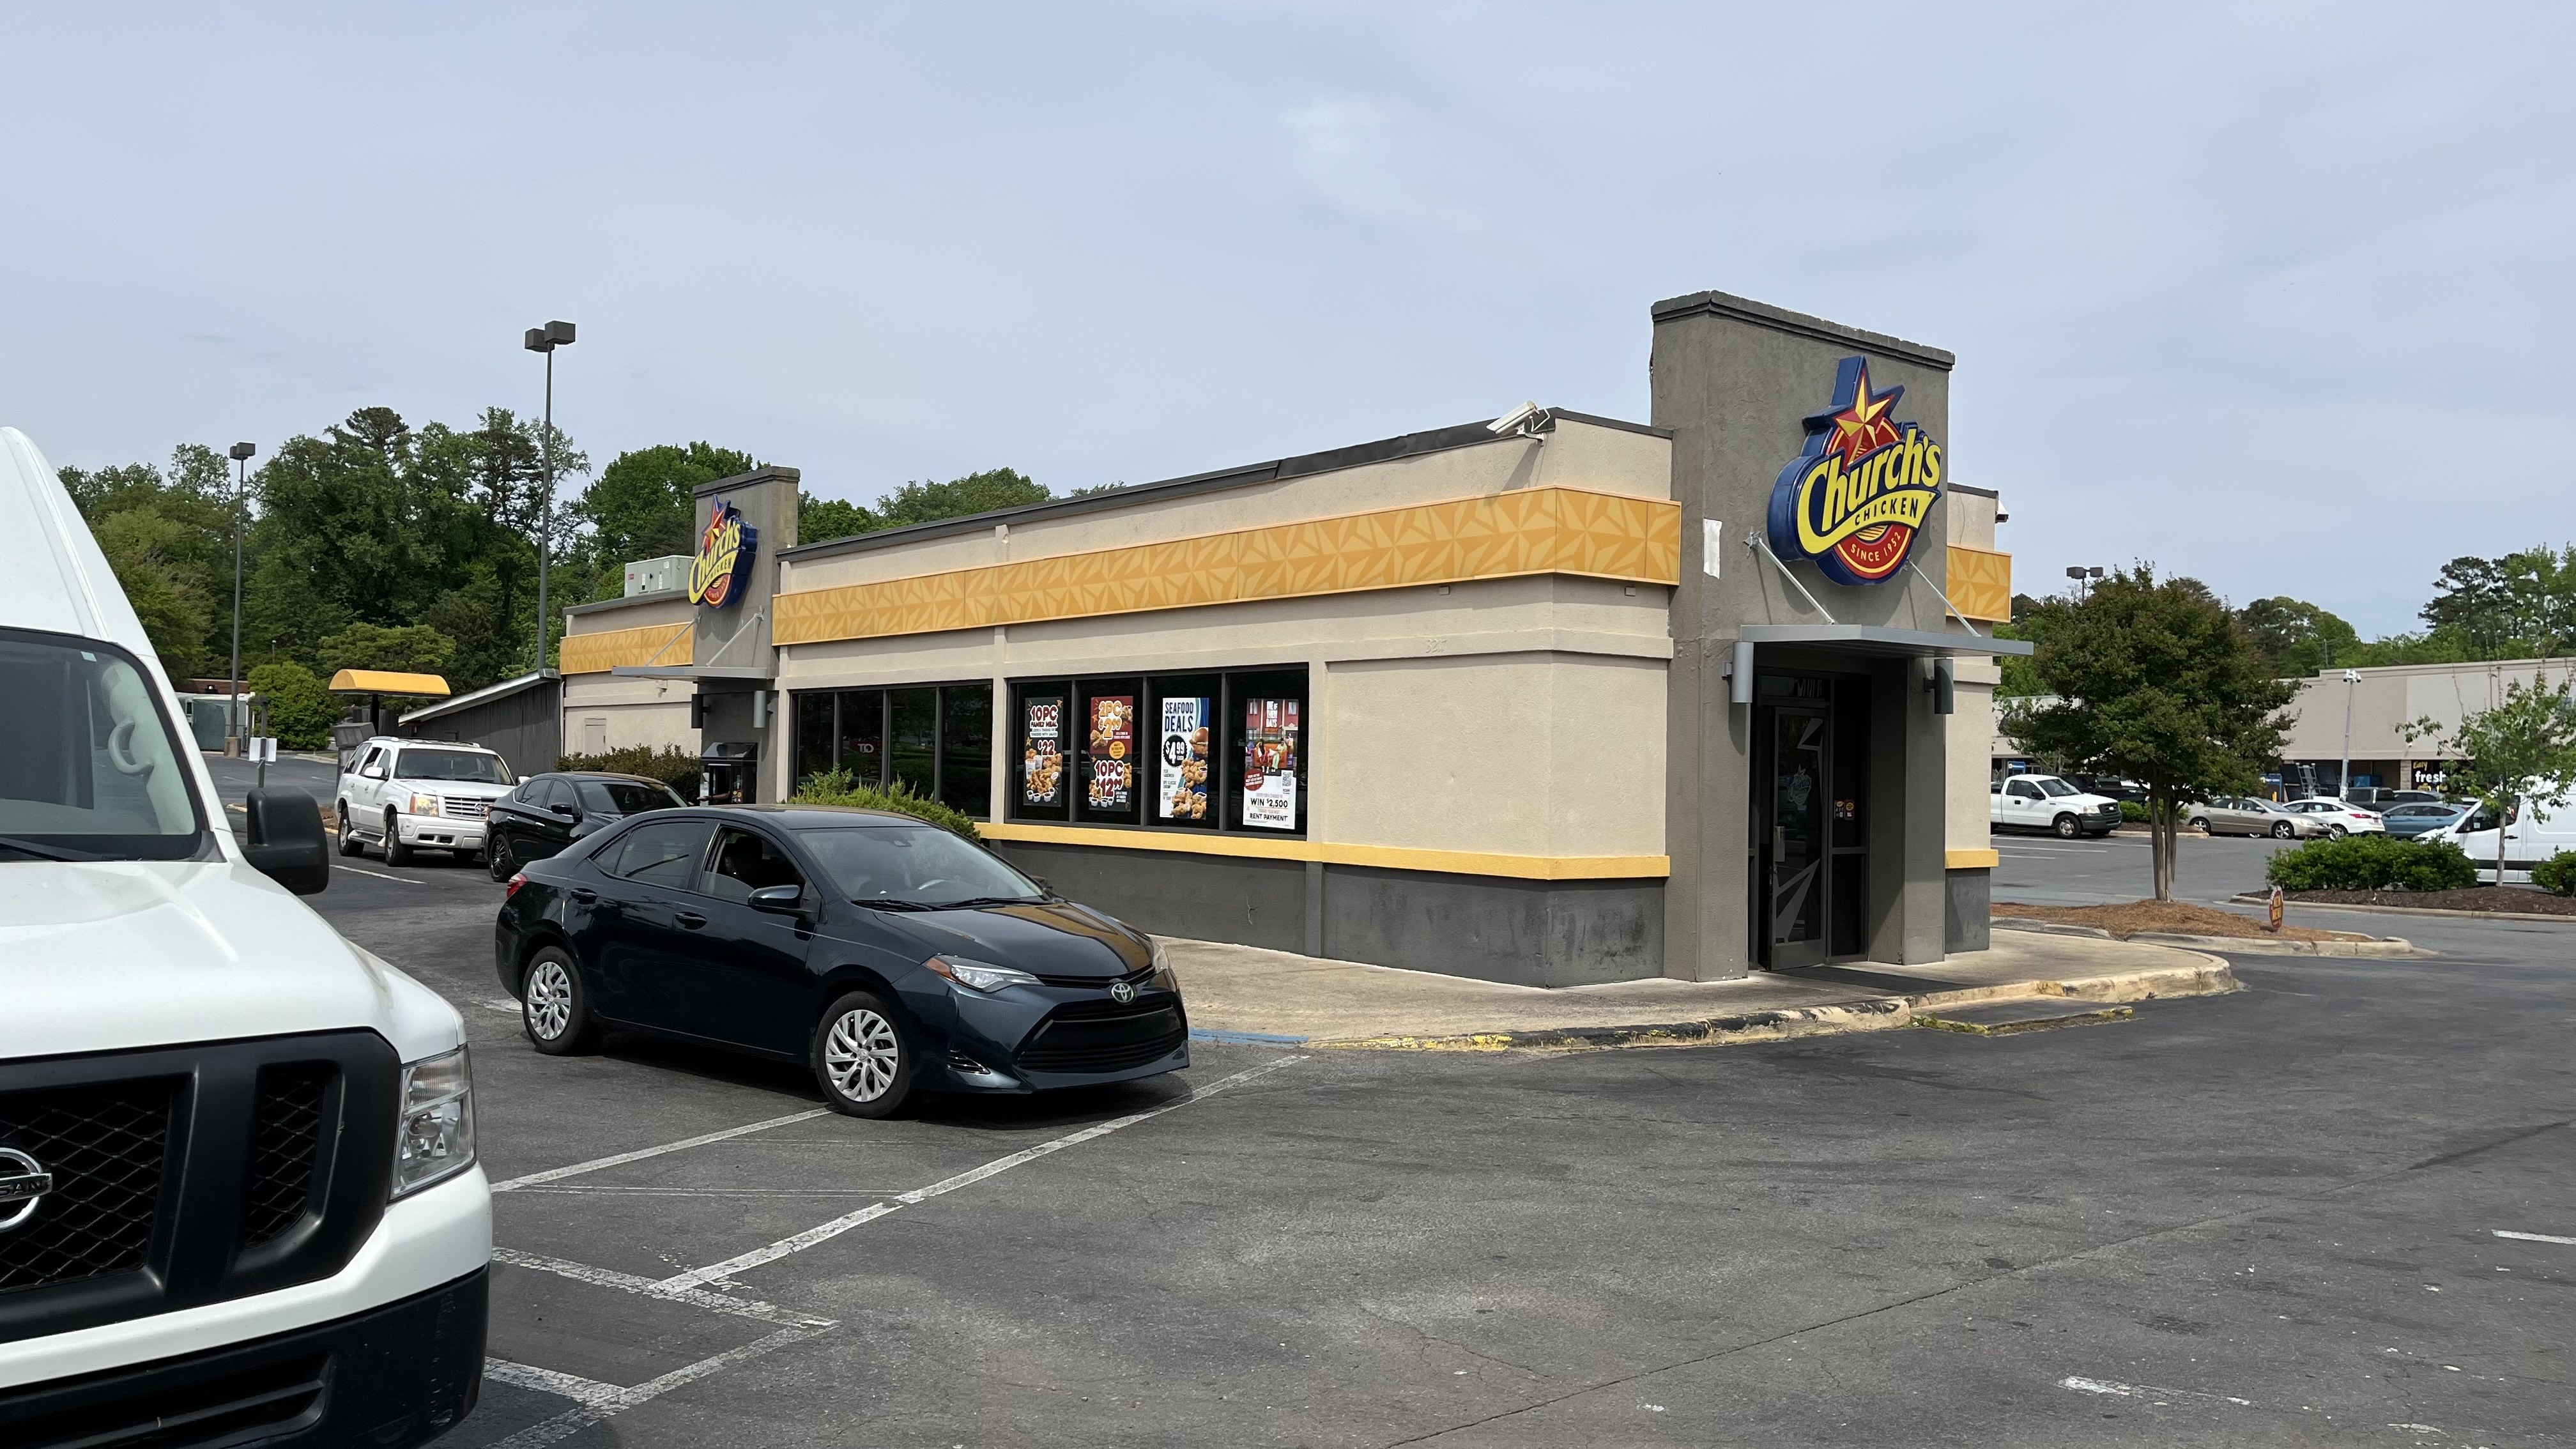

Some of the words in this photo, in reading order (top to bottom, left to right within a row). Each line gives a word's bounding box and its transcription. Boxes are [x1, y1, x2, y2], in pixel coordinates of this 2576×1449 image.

[1797, 429, 1941, 554] Church's
[1855, 497, 1919, 526] CHICKEN
[1850, 544, 1880, 562] SINCE
[1883, 532, 1901, 556] 1952
[689, 519, 740, 604] Church's
[707, 557, 732, 583] CHICKEN
[1031, 706, 1057, 721] 10PC
[1099, 702, 1121, 717] 2PC
[1165, 702, 1193, 714] SEAFOOD
[1165, 715, 1193, 732] DEALS
[1095, 762, 1123, 776] 10PC
[1250, 797, 1264, 806] WIN
[1266, 798, 1288, 808] $2,500
